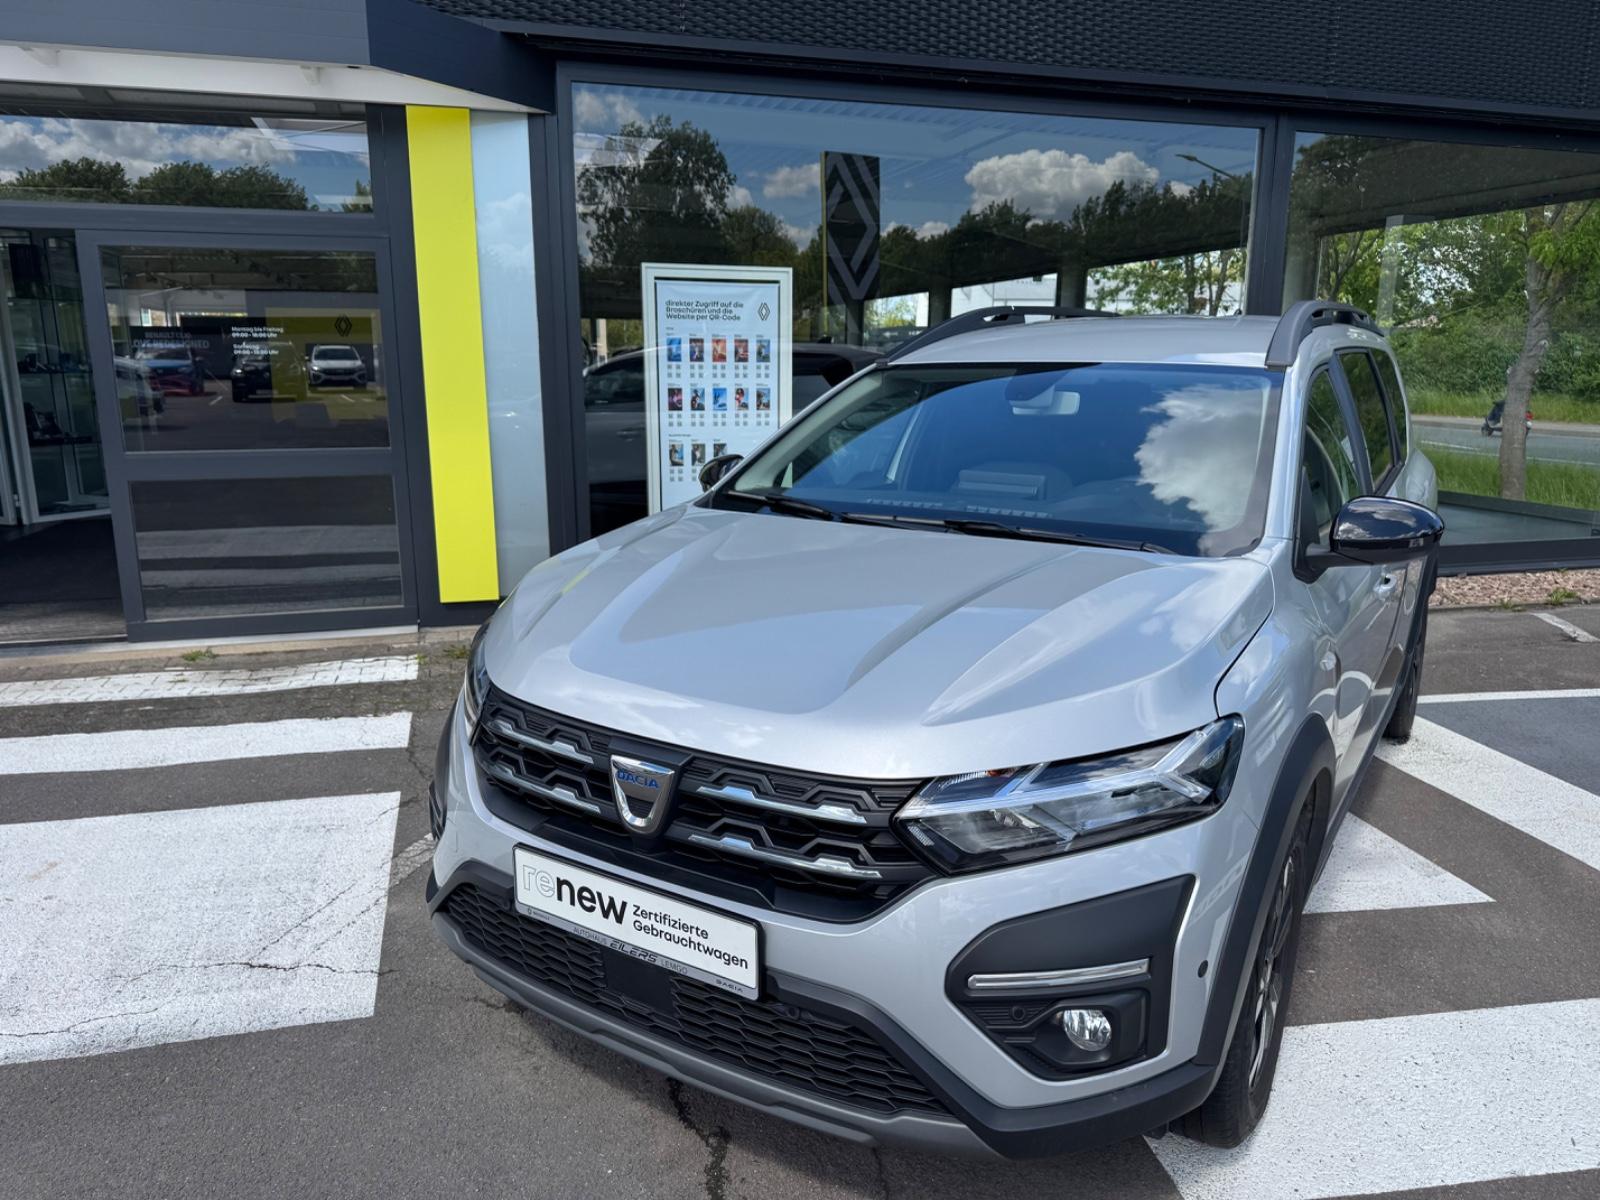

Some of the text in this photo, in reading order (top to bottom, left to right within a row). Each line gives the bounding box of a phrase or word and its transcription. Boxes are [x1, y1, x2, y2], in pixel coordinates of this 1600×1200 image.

[665, 300, 694, 308] direkter
[695, 301, 719, 309] Zugriff
[617, 768, 659, 788] DACIA
[522, 864, 628, 925] renew
[632, 903, 709, 940] Zertifizierte
[609, 939, 658, 963] EILERS
[632, 920, 749, 970] Gebrauchtwagen
